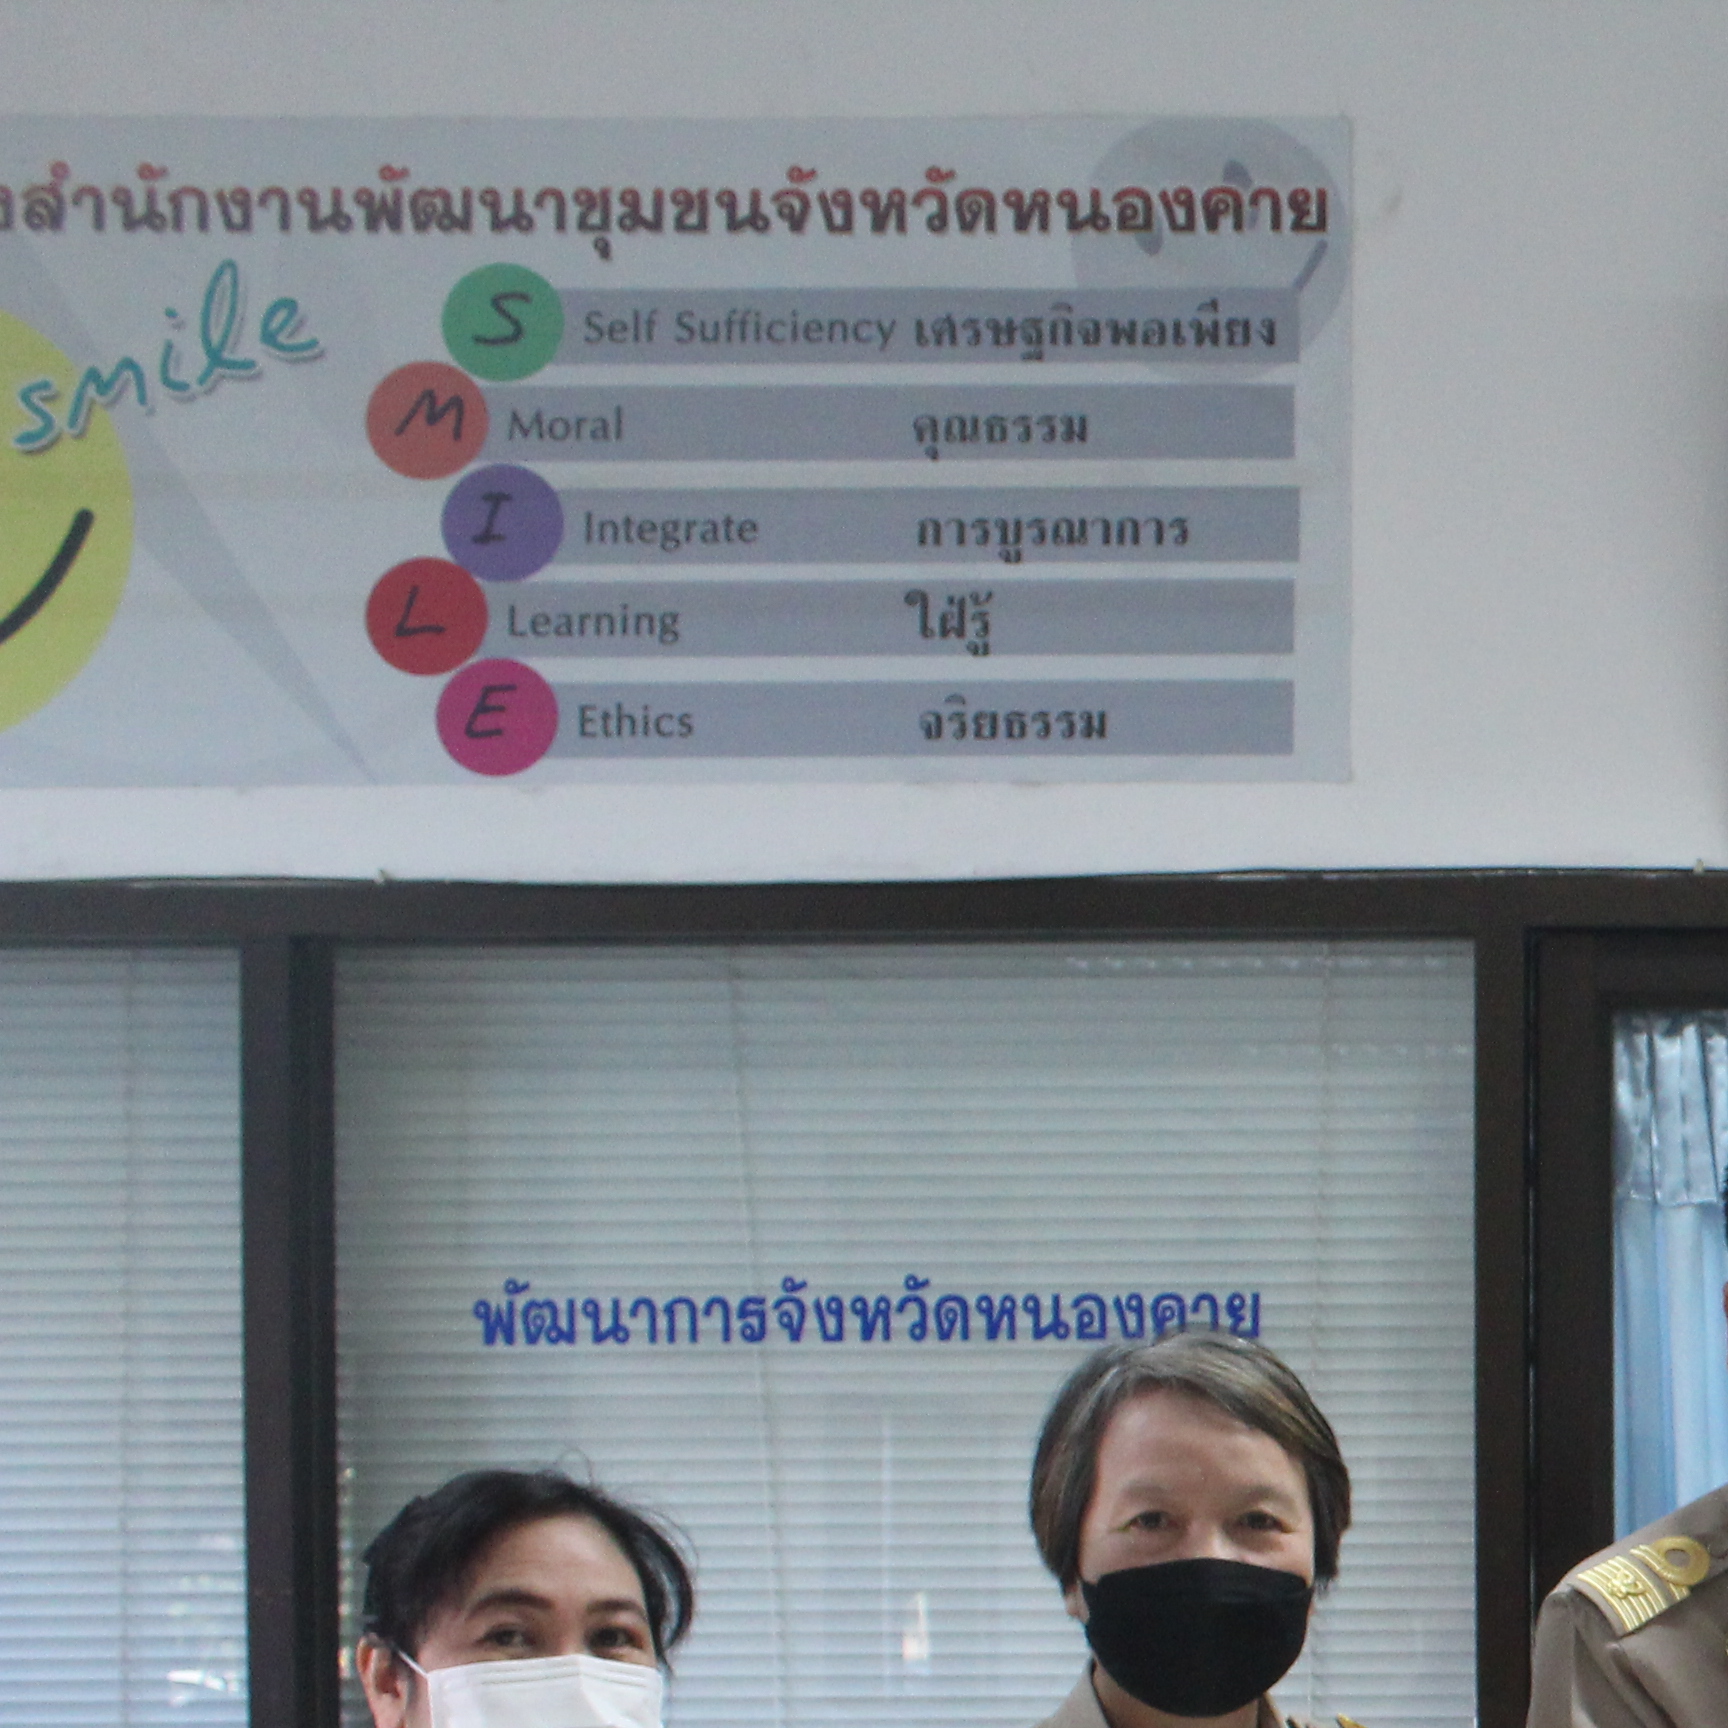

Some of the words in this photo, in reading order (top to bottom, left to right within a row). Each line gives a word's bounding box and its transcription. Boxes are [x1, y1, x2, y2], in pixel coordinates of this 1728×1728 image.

[473, 292, 532, 345] S
[584, 308, 657, 344] Self
[674, 308, 896, 351] Sufficiency
[914, 298, 1277, 361] เศรษฐกิจพอเพียง
[394, 388, 465, 441] M
[507, 406, 623, 441] Moral
[913, 413, 1088, 460] คุณธรรม
[584, 512, 760, 552] Integrate
[916, 515, 1189, 564] การบูรณาการ
[394, 585, 446, 637] L
[507, 604, 680, 643] Learning
[464, 684, 517, 740] E
[577, 701, 695, 740] Ethics
[918, 693, 1108, 741] จริยธรรม
[472, 1274, 1262, 1346] พัฒนาการจังหวัดหนองคาย
